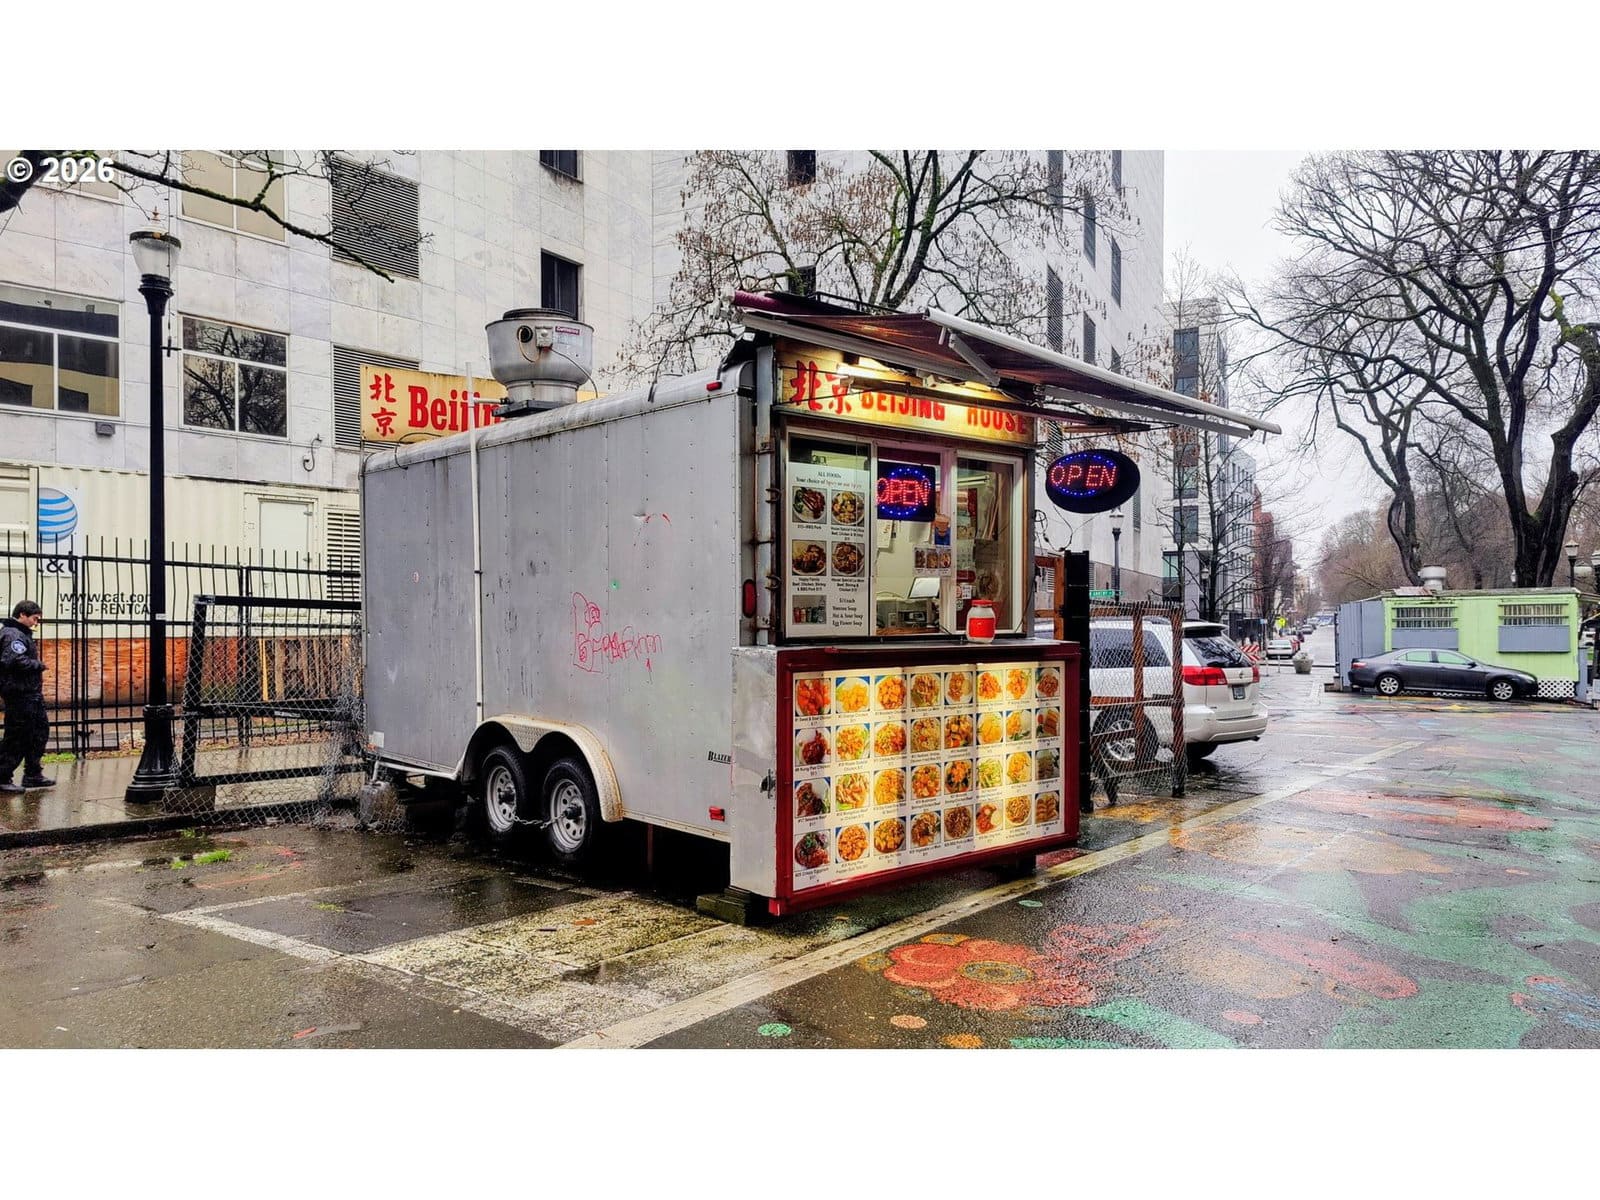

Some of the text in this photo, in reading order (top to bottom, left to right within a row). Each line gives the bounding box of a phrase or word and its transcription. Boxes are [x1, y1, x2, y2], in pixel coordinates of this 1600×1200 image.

[369, 373, 397, 437] 北京
[861, 391, 946, 422] BEIJING
[1050, 464, 1117, 488] OPEN
[876, 477, 930, 507] OPEN
